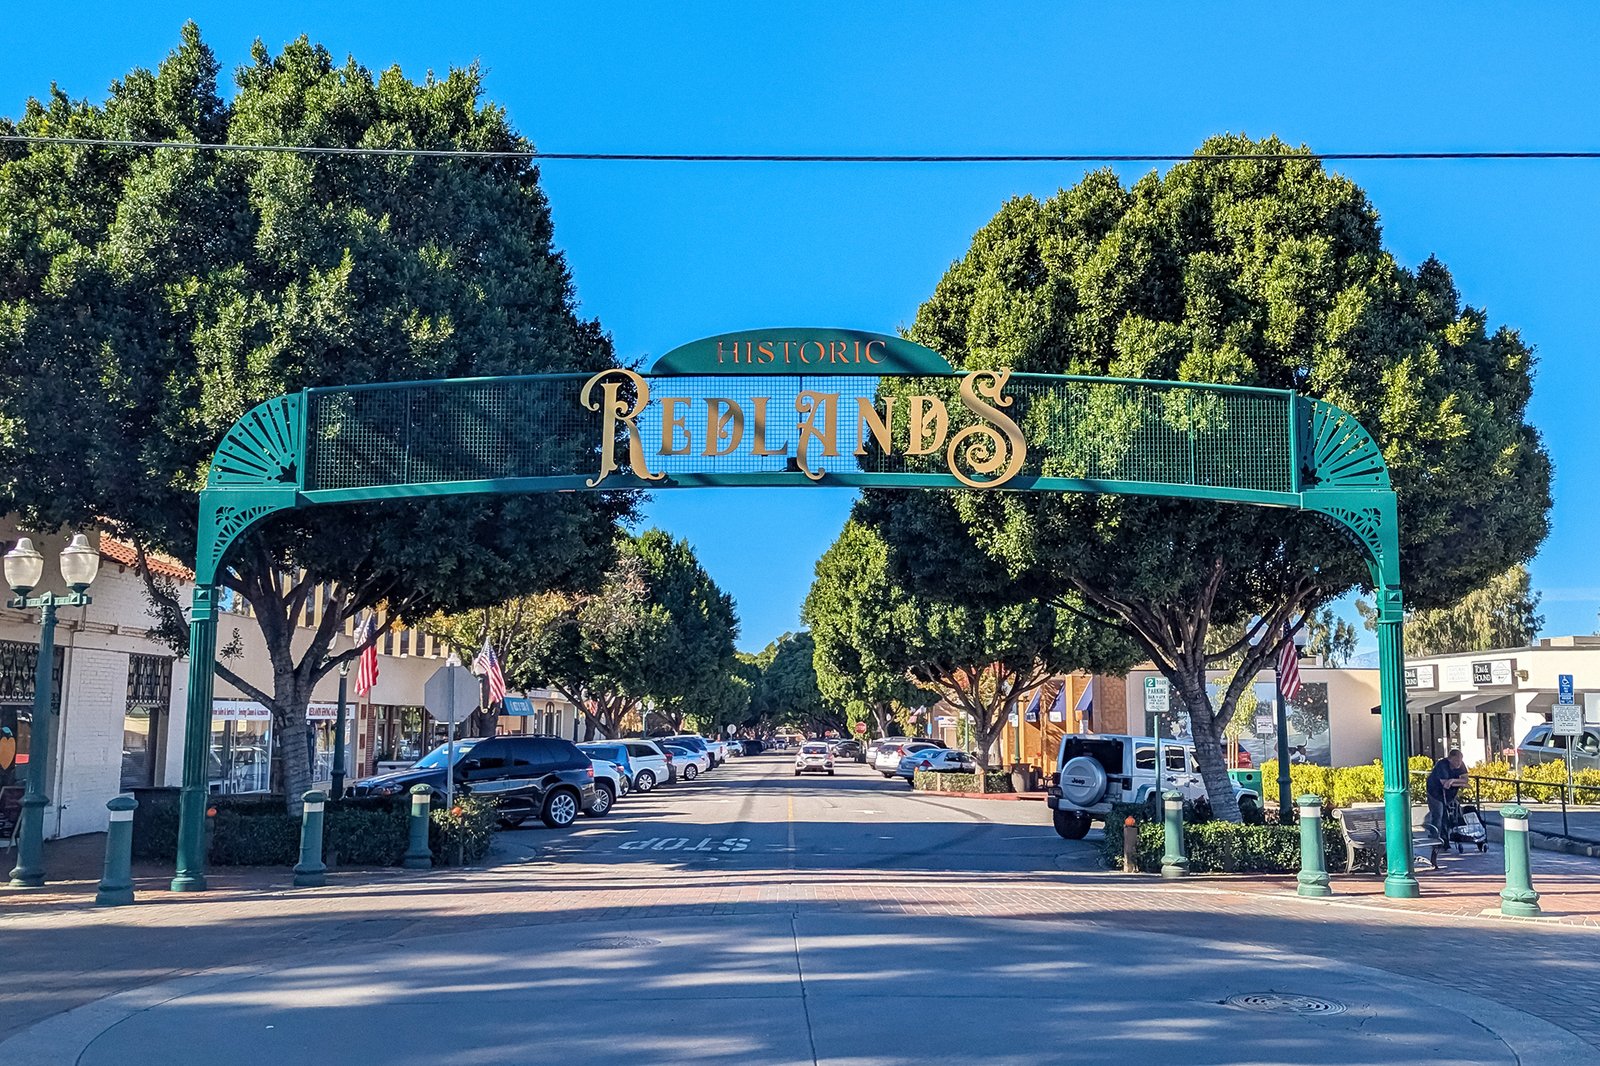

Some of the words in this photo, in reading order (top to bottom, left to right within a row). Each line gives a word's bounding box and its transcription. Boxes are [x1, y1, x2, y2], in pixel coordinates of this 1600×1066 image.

[718, 340, 888, 364] HISTORIC
[580, 367, 1027, 488] REDLANDS
[1148, 678, 1154, 687] 2
[1071, 777, 1085, 785] Jeep
[618, 837, 751, 852] STOP
